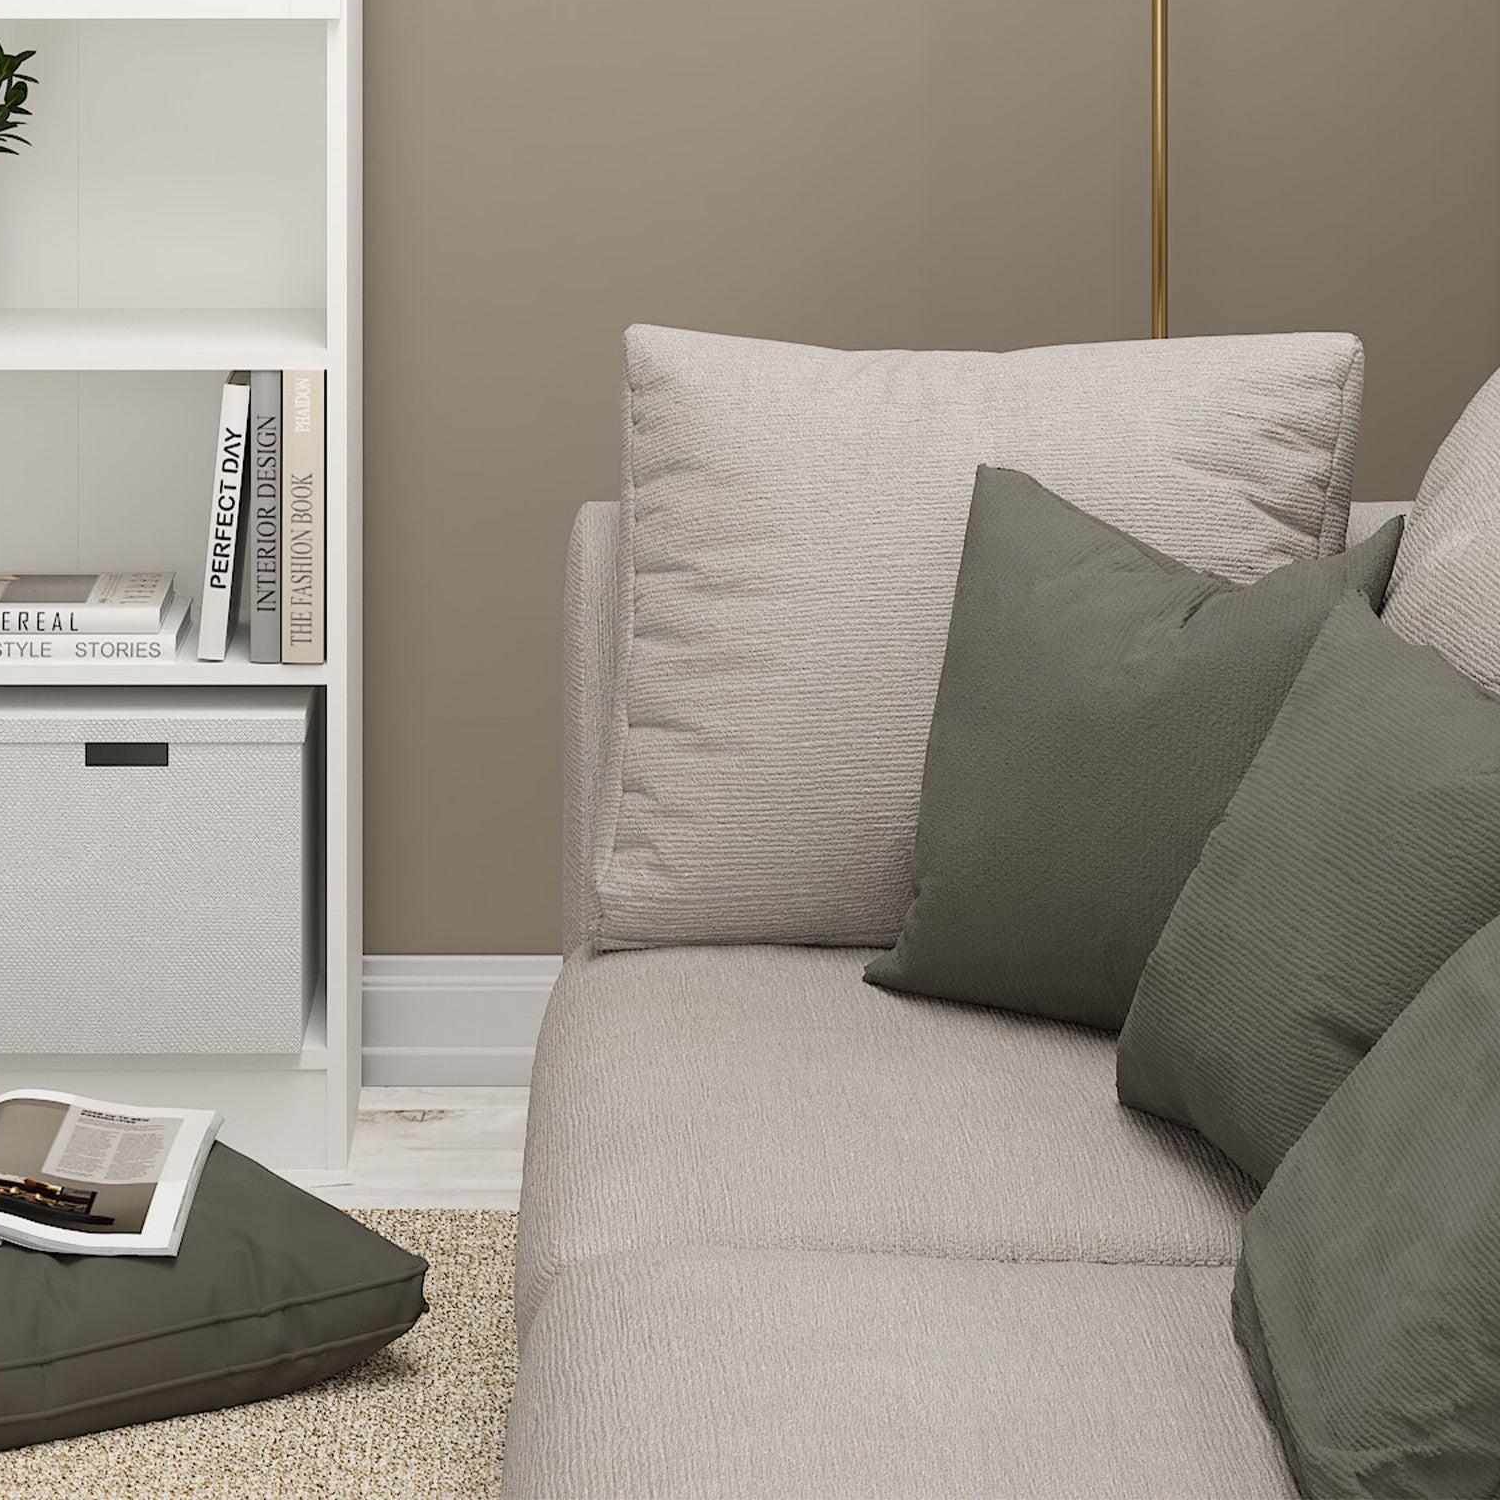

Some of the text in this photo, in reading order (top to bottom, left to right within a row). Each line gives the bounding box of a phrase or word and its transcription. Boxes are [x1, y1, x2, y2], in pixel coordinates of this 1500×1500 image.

[210, 480, 236, 589] PERFECT
[257, 415, 276, 612] INTERIOR DESIGN
[291, 473, 313, 647] THE FASHION BOOK
[75, 642, 161, 658] STORIES
